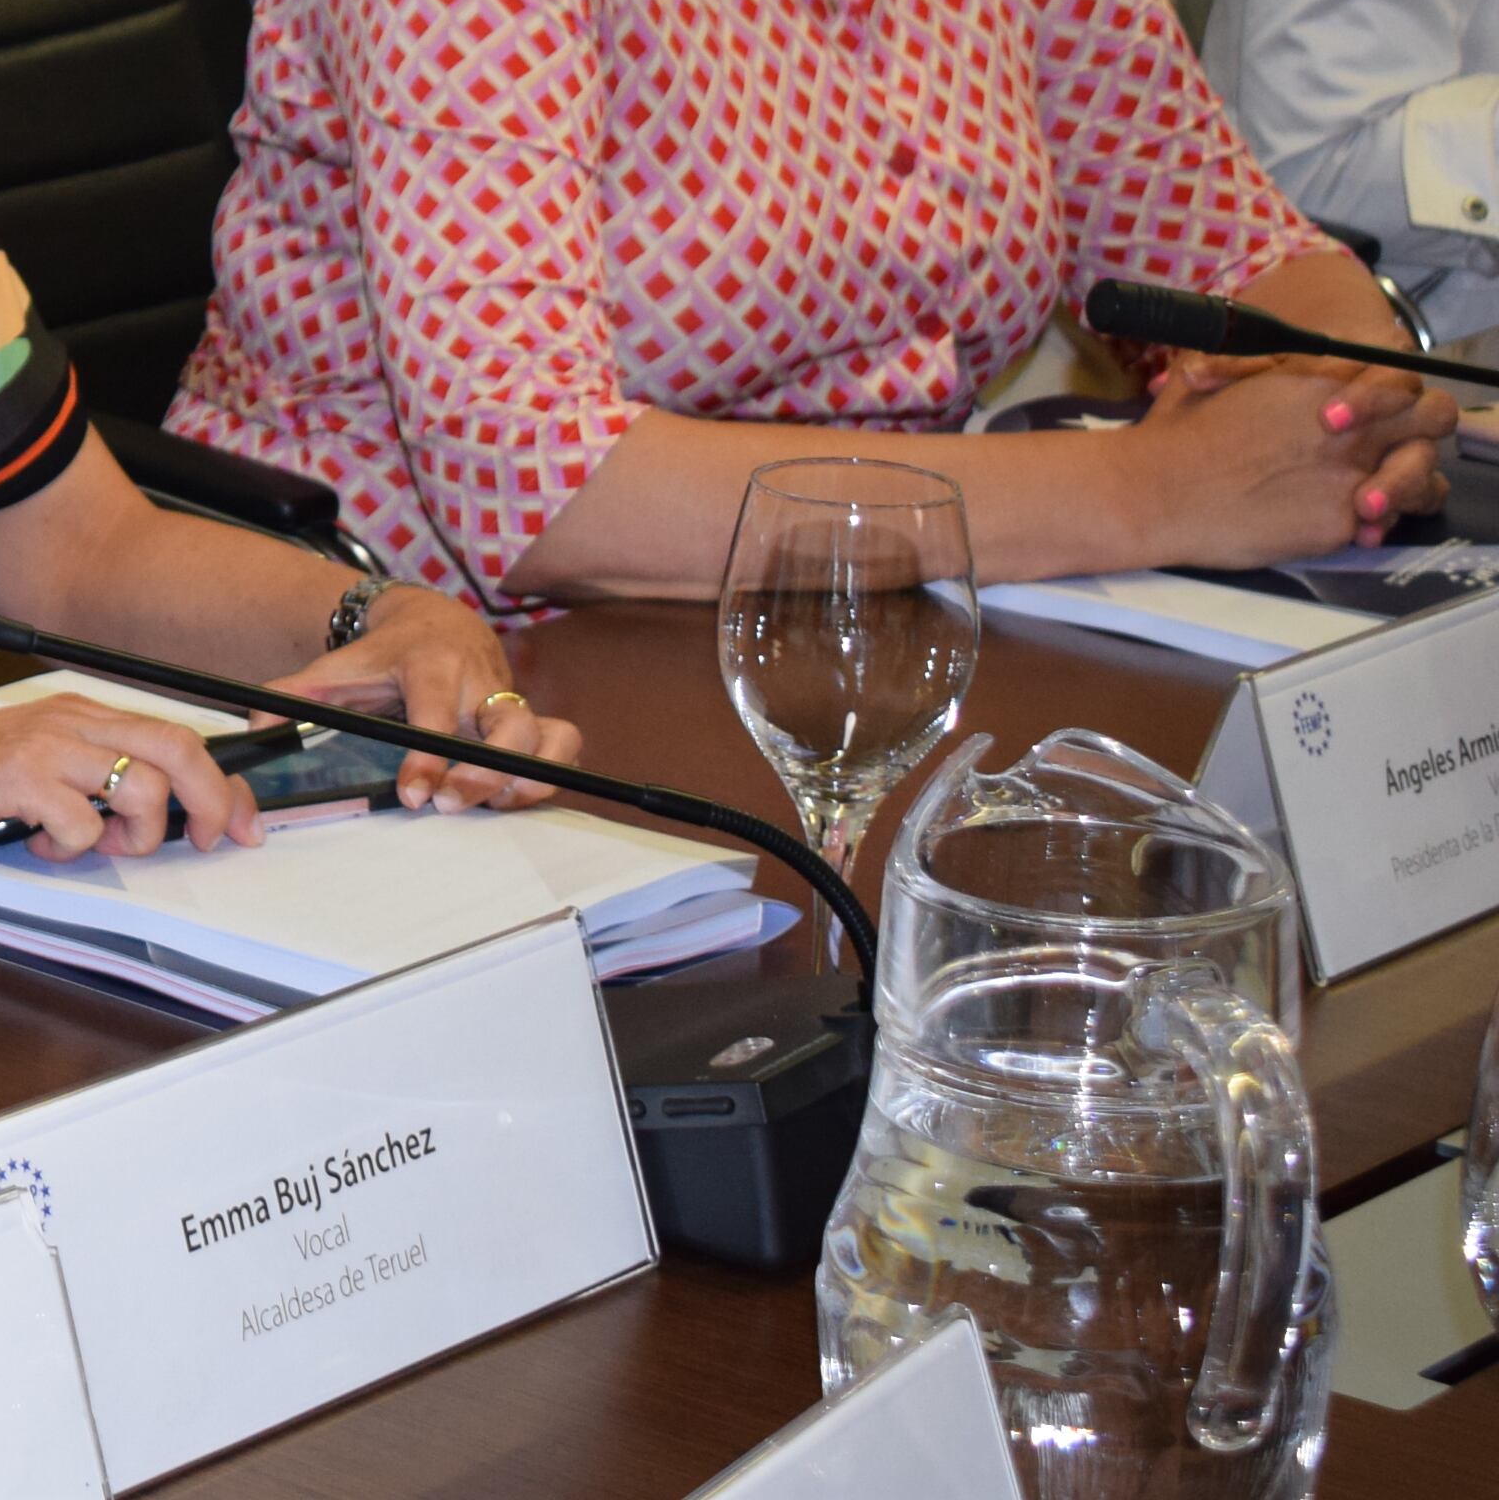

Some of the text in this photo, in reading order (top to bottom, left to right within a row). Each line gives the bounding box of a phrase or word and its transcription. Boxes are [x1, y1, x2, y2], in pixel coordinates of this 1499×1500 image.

[1386, 747, 1456, 797] Ángeles
[1458, 723, 1499, 767] Armi
[1390, 835, 1462, 883] Presidenta
[1462, 825, 1480, 852] de
[1479, 819, 1494, 844] la
[180, 1126, 436, 1254] Emma Buj Sánchez
[293, 1211, 352, 1262] Vocal
[240, 1232, 429, 1342] Alcaldesa de Teruel
